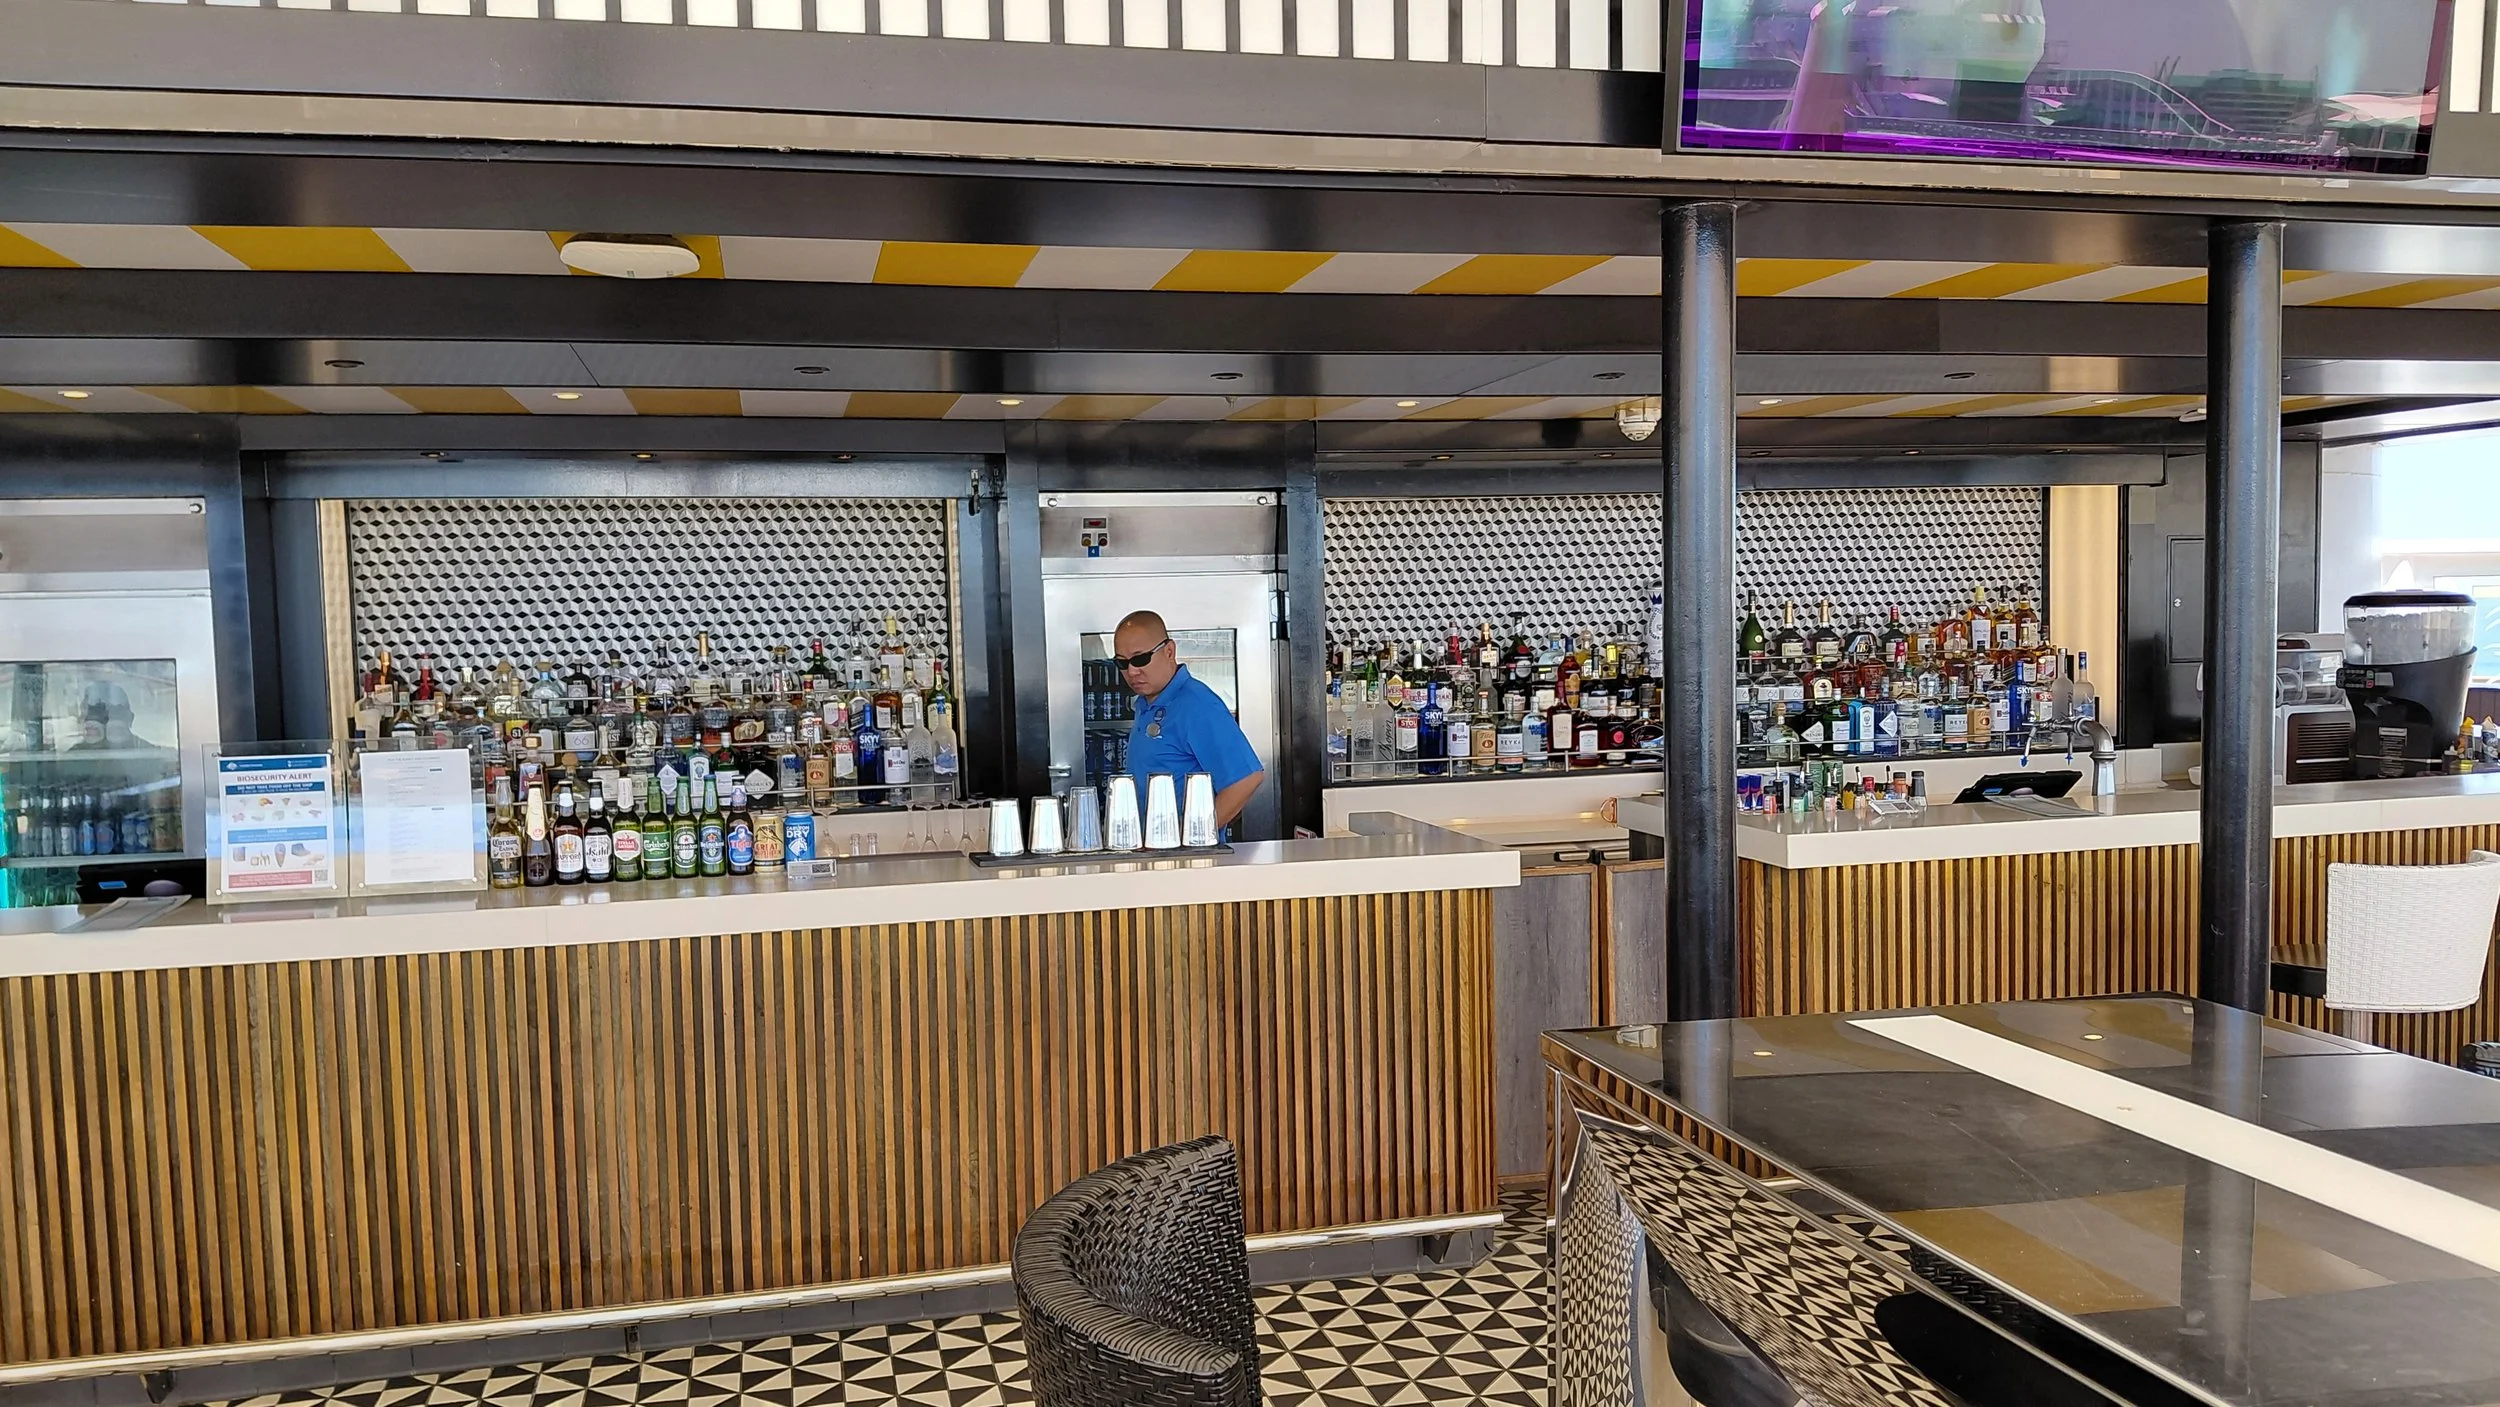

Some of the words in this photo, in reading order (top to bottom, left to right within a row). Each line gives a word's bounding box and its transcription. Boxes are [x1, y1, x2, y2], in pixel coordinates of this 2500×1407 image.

[859, 734, 880, 744] SKYY
[237, 773, 287, 783] BIOSECURITY
[288, 772, 313, 780] ALERT
[786, 830, 809, 838] DRY
[492, 838, 518, 848] Corona
[643, 840, 670, 849] Carlsberg
[755, 843, 778, 851] GREAT
